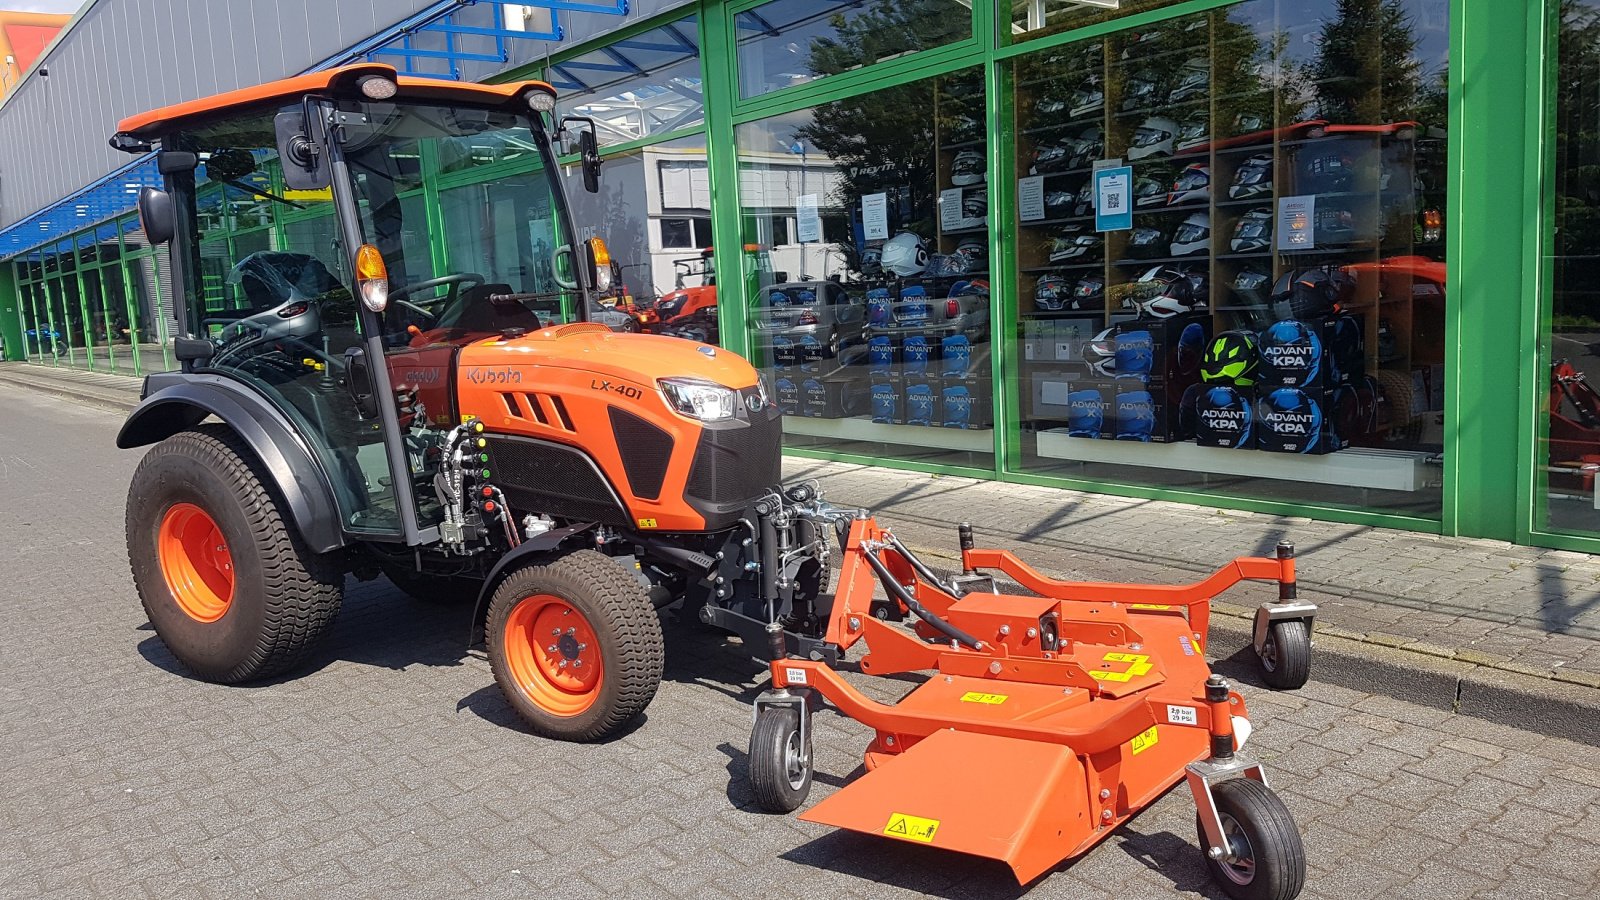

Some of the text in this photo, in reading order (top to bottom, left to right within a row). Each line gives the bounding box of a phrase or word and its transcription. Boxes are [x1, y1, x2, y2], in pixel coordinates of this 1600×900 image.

[879, 303, 885, 311] X
[905, 345, 933, 353] ADVANT
[944, 345, 975, 353] ADVANT
[1118, 343, 1162, 351] ADVANT
[1264, 346, 1315, 356] ADVANT
[1136, 351, 1144, 359] X
[1273, 356, 1306, 366] KPA
[467, 366, 522, 384] Kubota
[591, 379, 643, 400] LX-401
[908, 394, 939, 402] ADVANT
[945, 396, 976, 404] ADVANT
[920, 401, 927, 409] X
[1071, 401, 1111, 410] ADVANT
[1120, 402, 1163, 412] ADVANT
[1087, 409, 1096, 418] X
[1136, 411, 1144, 420] X
[1201, 409, 1248, 419] ADVANT
[1265, 412, 1315, 423] ADVANT
[1209, 419, 1238, 430] KPA
[1274, 423, 1306, 434] KPA
